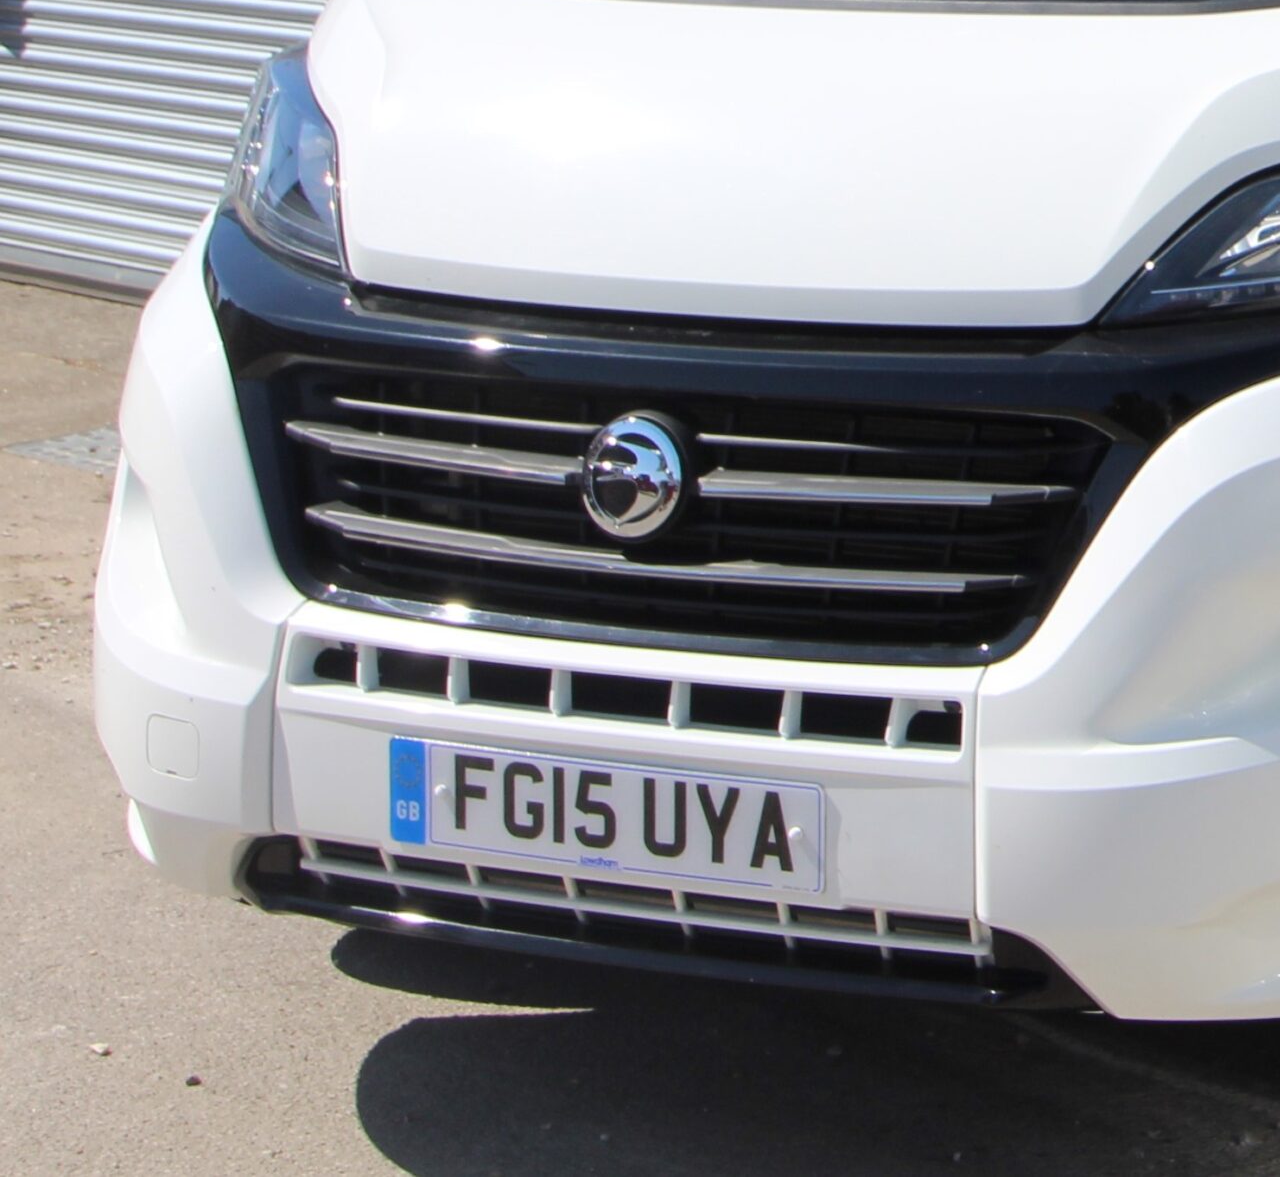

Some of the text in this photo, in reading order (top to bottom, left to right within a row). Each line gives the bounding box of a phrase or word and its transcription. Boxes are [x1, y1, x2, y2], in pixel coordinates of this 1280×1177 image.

[396, 799, 421, 822] GB
[454, 753, 795, 873] FG15 UYA
